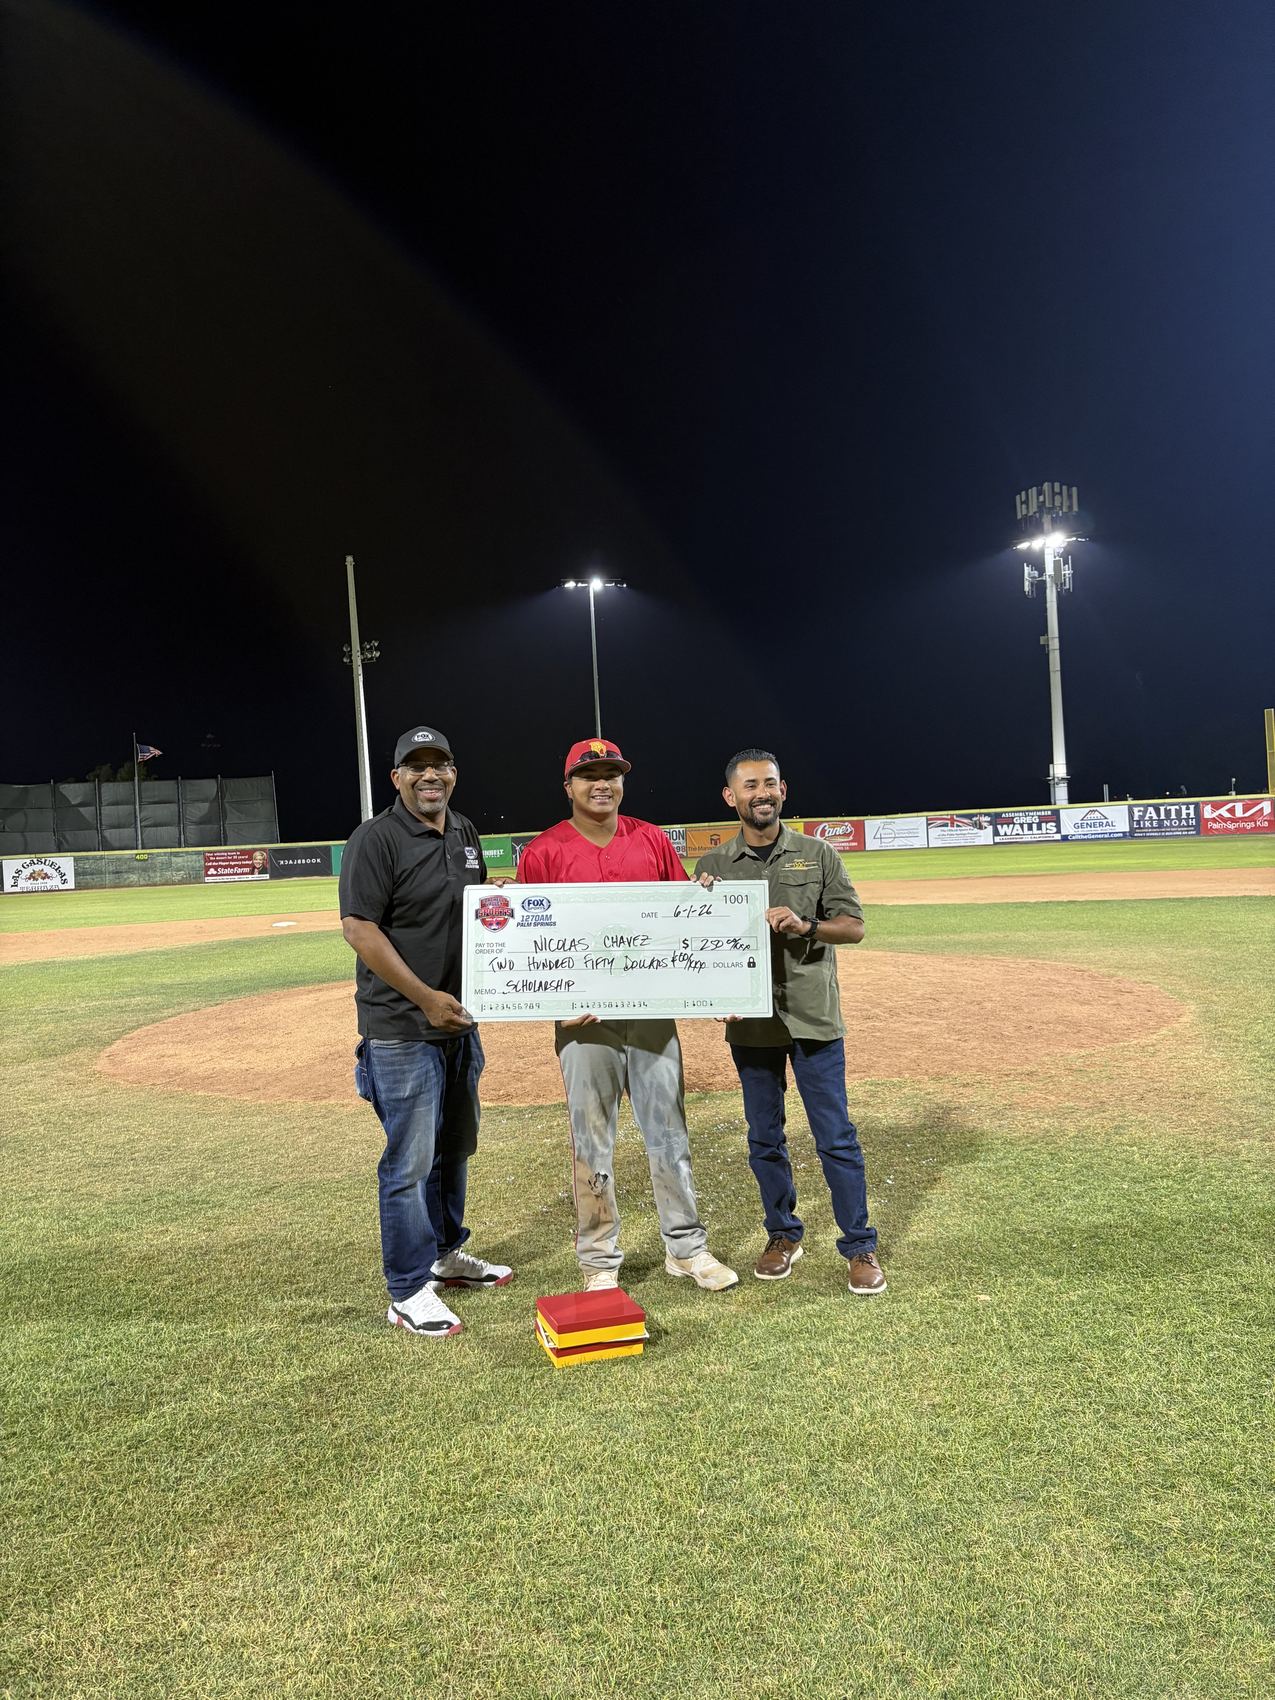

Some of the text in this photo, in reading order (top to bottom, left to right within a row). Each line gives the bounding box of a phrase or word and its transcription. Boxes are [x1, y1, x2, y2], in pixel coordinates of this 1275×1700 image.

[1133, 804, 1196, 820] FAITH
[1203, 800, 1272, 818] KIA
[1013, 816, 1039, 824] GREG
[1073, 820, 1116, 829] GENERAL
[1133, 819, 1196, 828] LIKE NOAH
[1207, 819, 1269, 830] Palm Springs Kia
[816, 822, 853, 840] Cane's
[997, 822, 1057, 836] WALLIS
[11, 868, 23, 888] LAS
[527, 899, 545, 907] FOX
[723, 894, 749, 904] 1001
[673, 904, 713, 918] 6-1-26
[520, 914, 553, 922] 1270AM
[533, 934, 653, 954] NICOLAS CHAVEZ
[682, 938, 690, 950] $
[527, 956, 575, 972] HUNDRED
[712, 961, 744, 969] DOLLARS
[505, 978, 575, 993] SCHOLARSHIP
